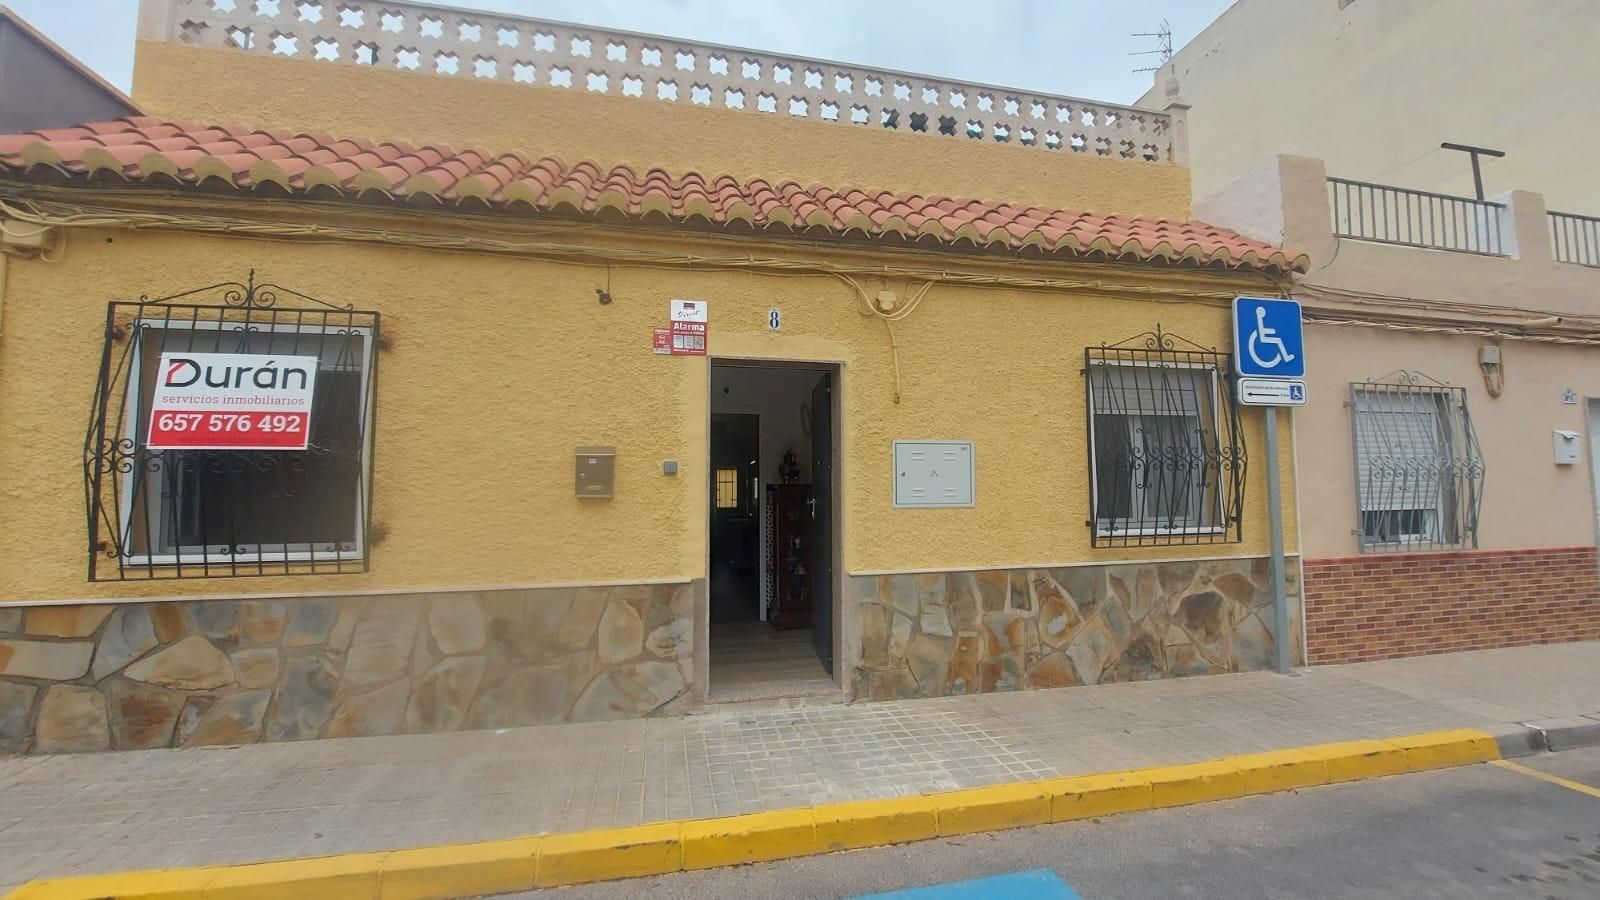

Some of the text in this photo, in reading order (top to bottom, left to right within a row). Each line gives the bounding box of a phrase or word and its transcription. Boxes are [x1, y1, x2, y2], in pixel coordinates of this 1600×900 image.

[673, 322, 705, 332] Alarma
[769, 311, 779, 329] 8
[165, 358, 307, 390] Durán
[162, 394, 305, 406] servicios inmobiliarios
[158, 413, 301, 433] 657 576 492
